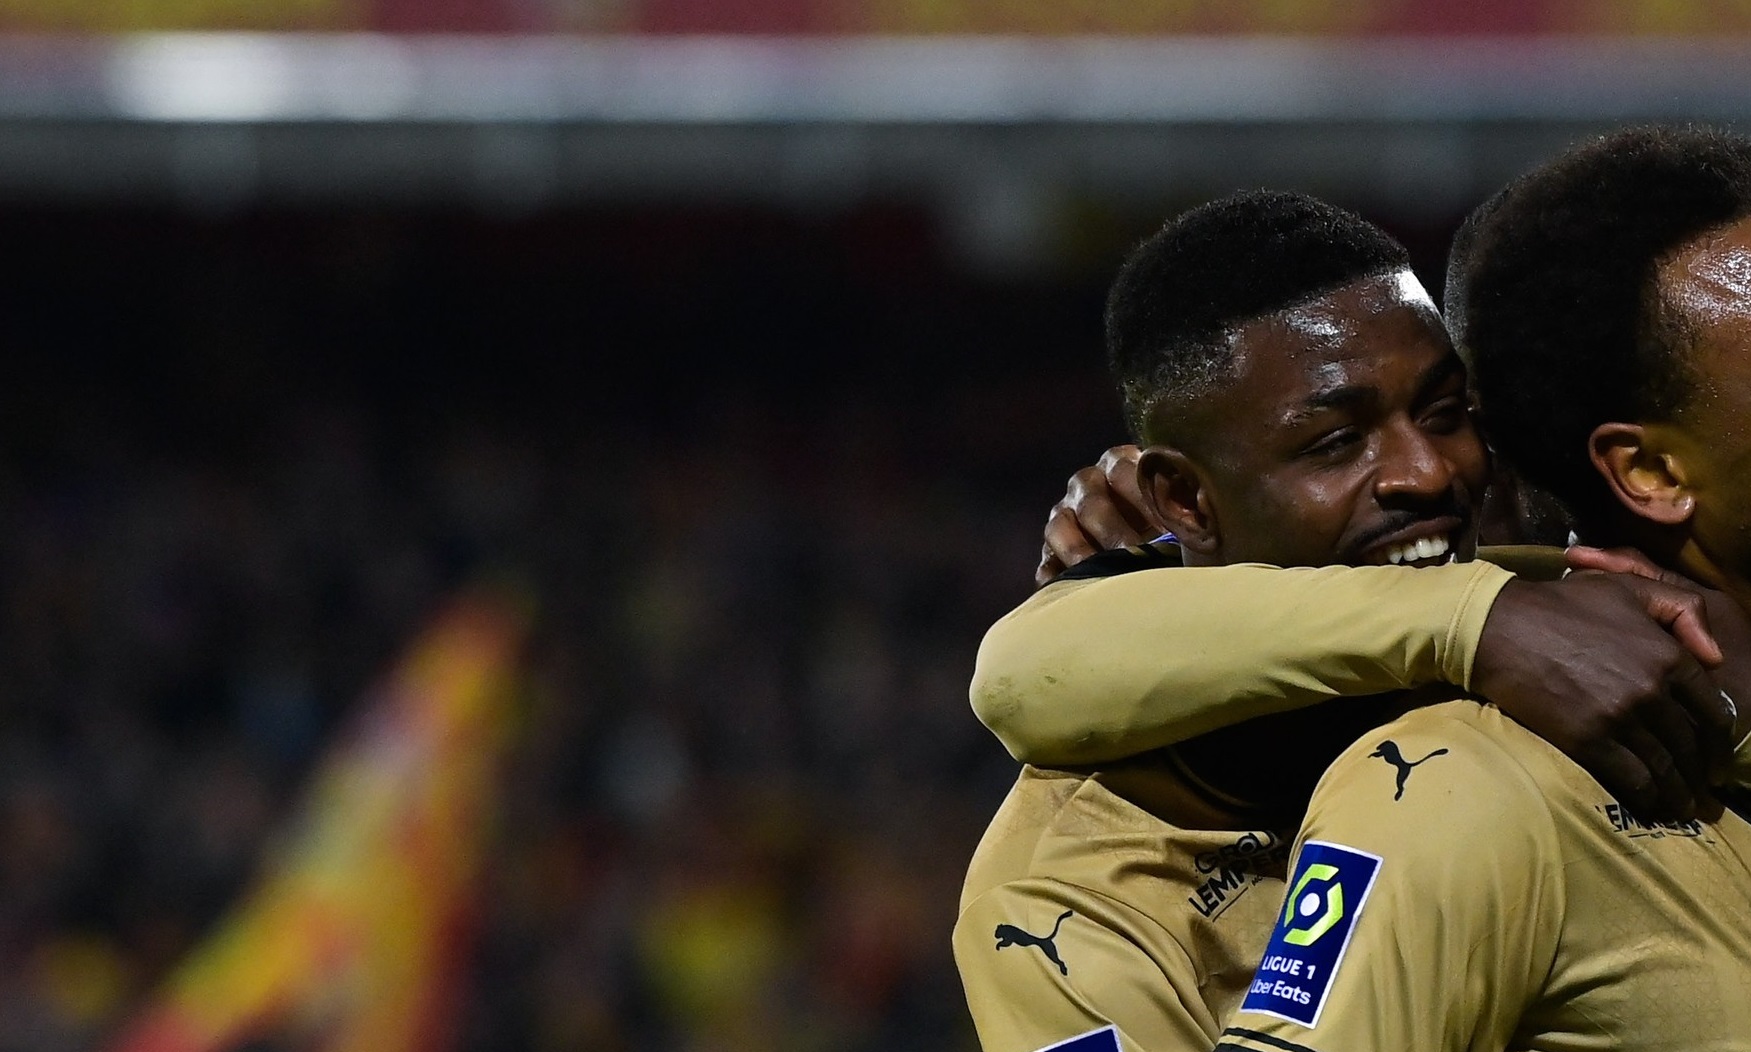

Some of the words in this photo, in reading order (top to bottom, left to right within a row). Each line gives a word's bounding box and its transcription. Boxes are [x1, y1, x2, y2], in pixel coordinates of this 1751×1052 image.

[1261, 954, 1304, 976] LIGUE
[1306, 965, 1317, 980] 1
[1250, 978, 1274, 994] Uber
[1272, 980, 1312, 1005] Eats
